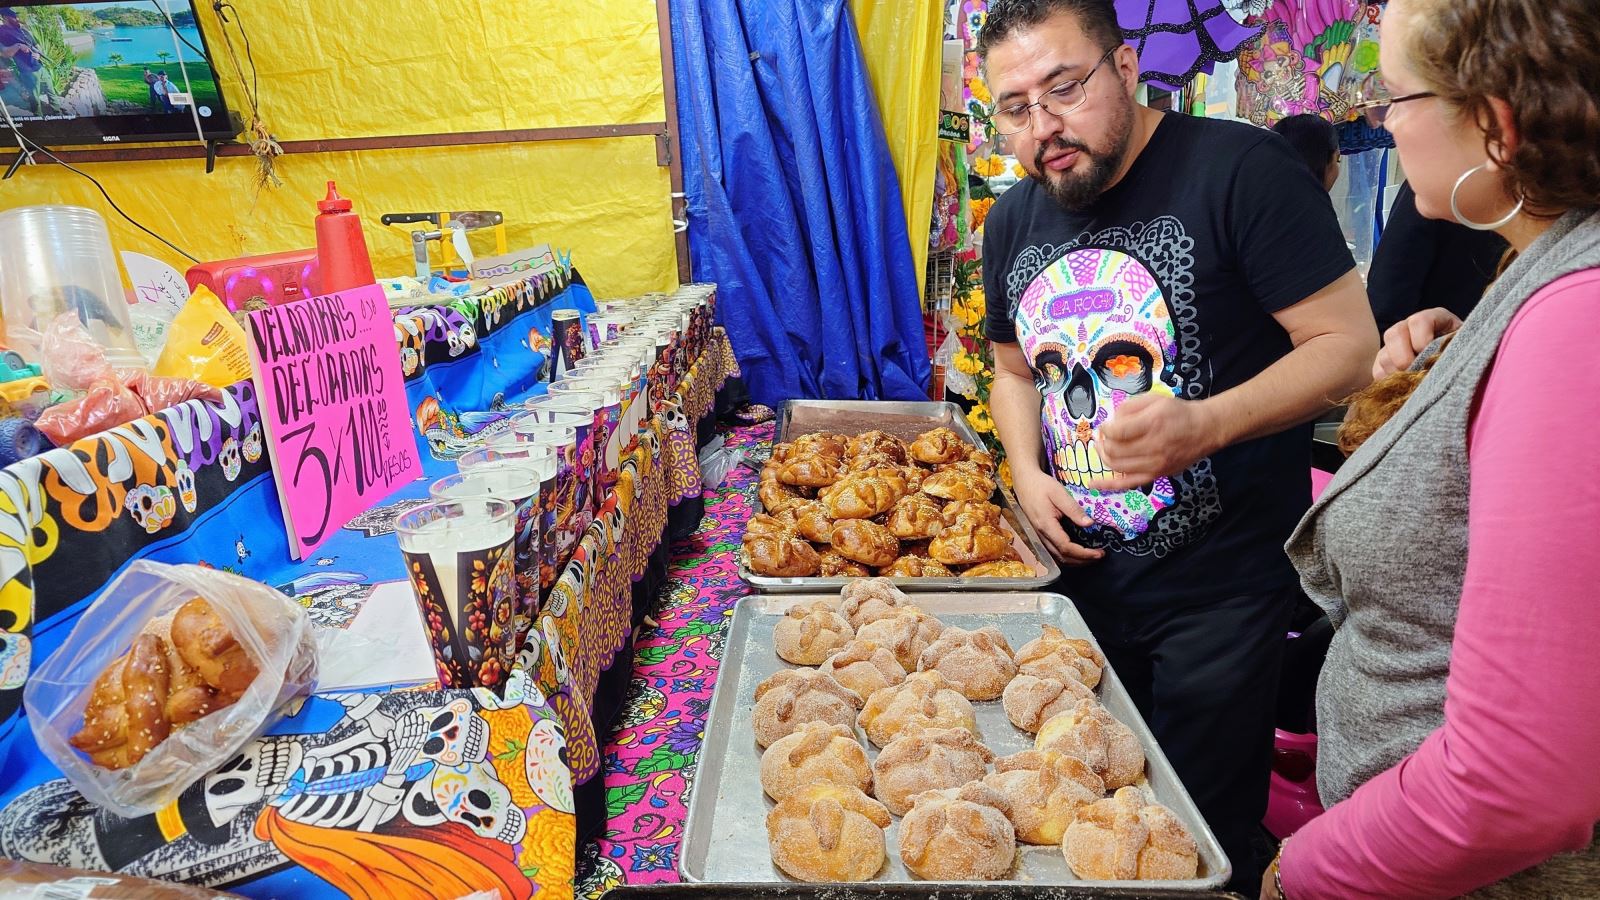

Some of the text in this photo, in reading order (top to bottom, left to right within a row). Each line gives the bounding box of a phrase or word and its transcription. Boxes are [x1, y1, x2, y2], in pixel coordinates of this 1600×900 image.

[248, 294, 357, 363] VELADORAS
[272, 343, 384, 426] DECORADAS
[280, 421, 332, 547] 3
[383, 448, 412, 489] PESOS
